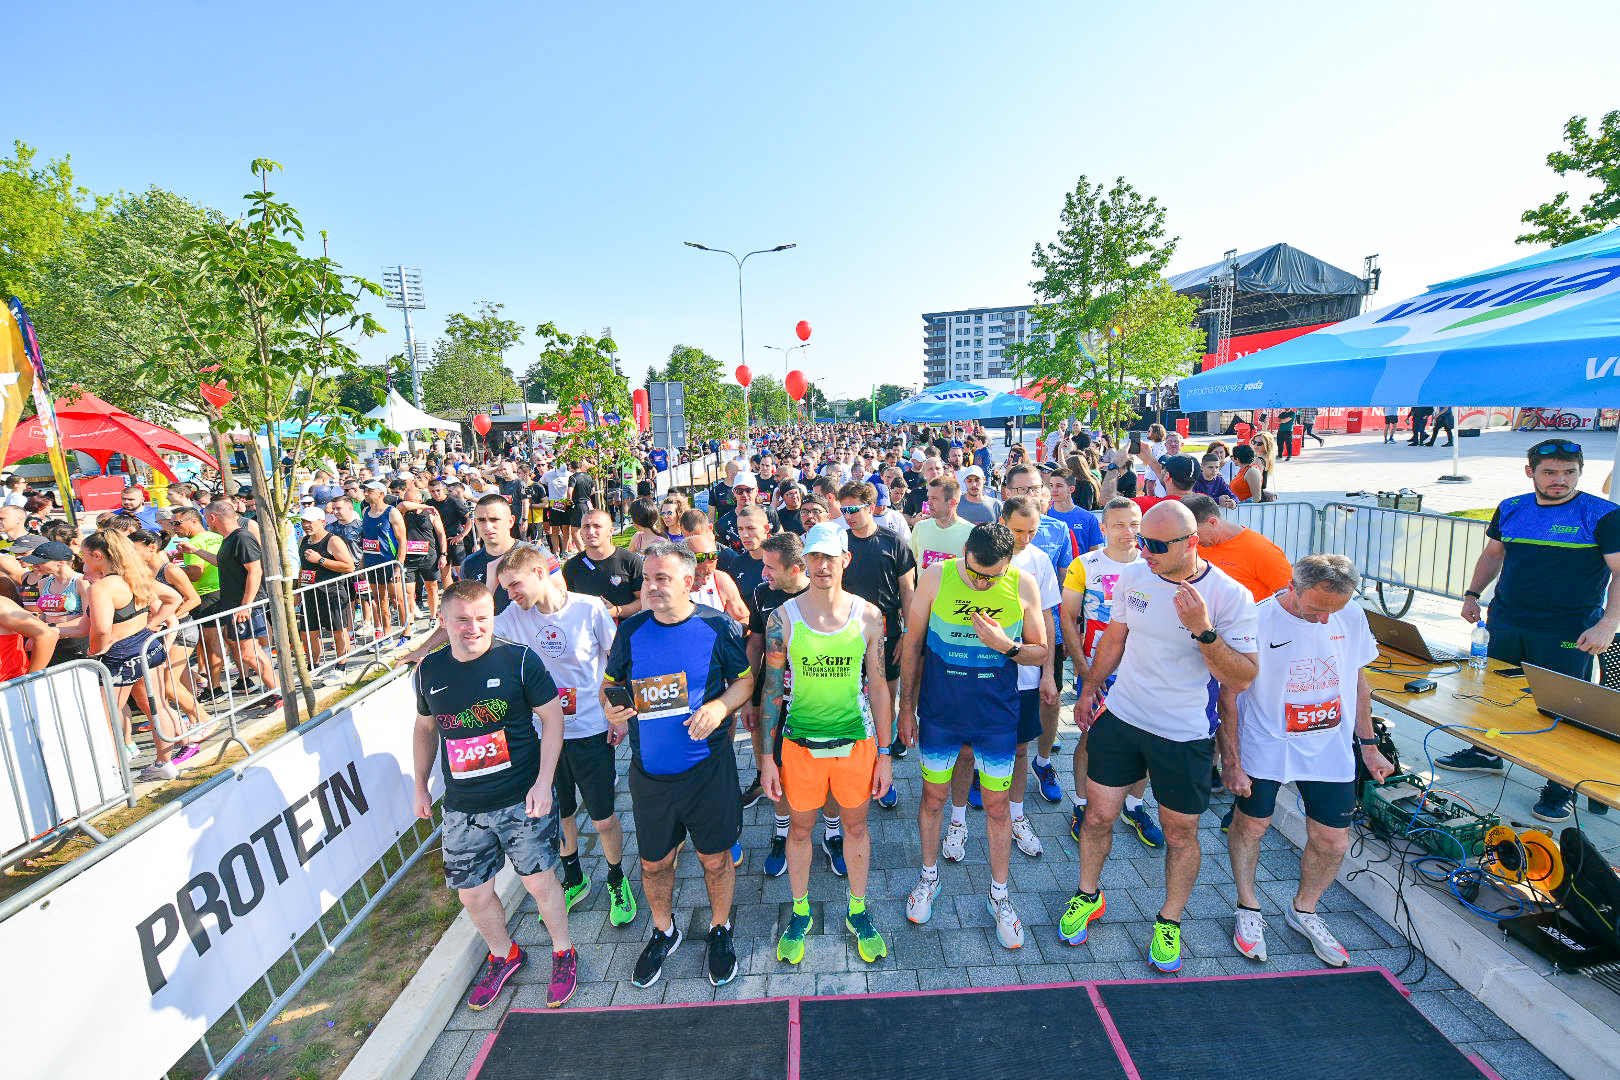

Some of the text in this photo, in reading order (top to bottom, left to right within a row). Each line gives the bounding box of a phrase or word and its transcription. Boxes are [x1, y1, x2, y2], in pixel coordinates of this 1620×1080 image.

[1244, 380, 1263, 391] voda
[640, 683, 680, 702] 1065
[1298, 707, 1336, 724] 5196
[454, 743, 497, 762] 2493
[136, 761, 370, 996] PROTEIN
